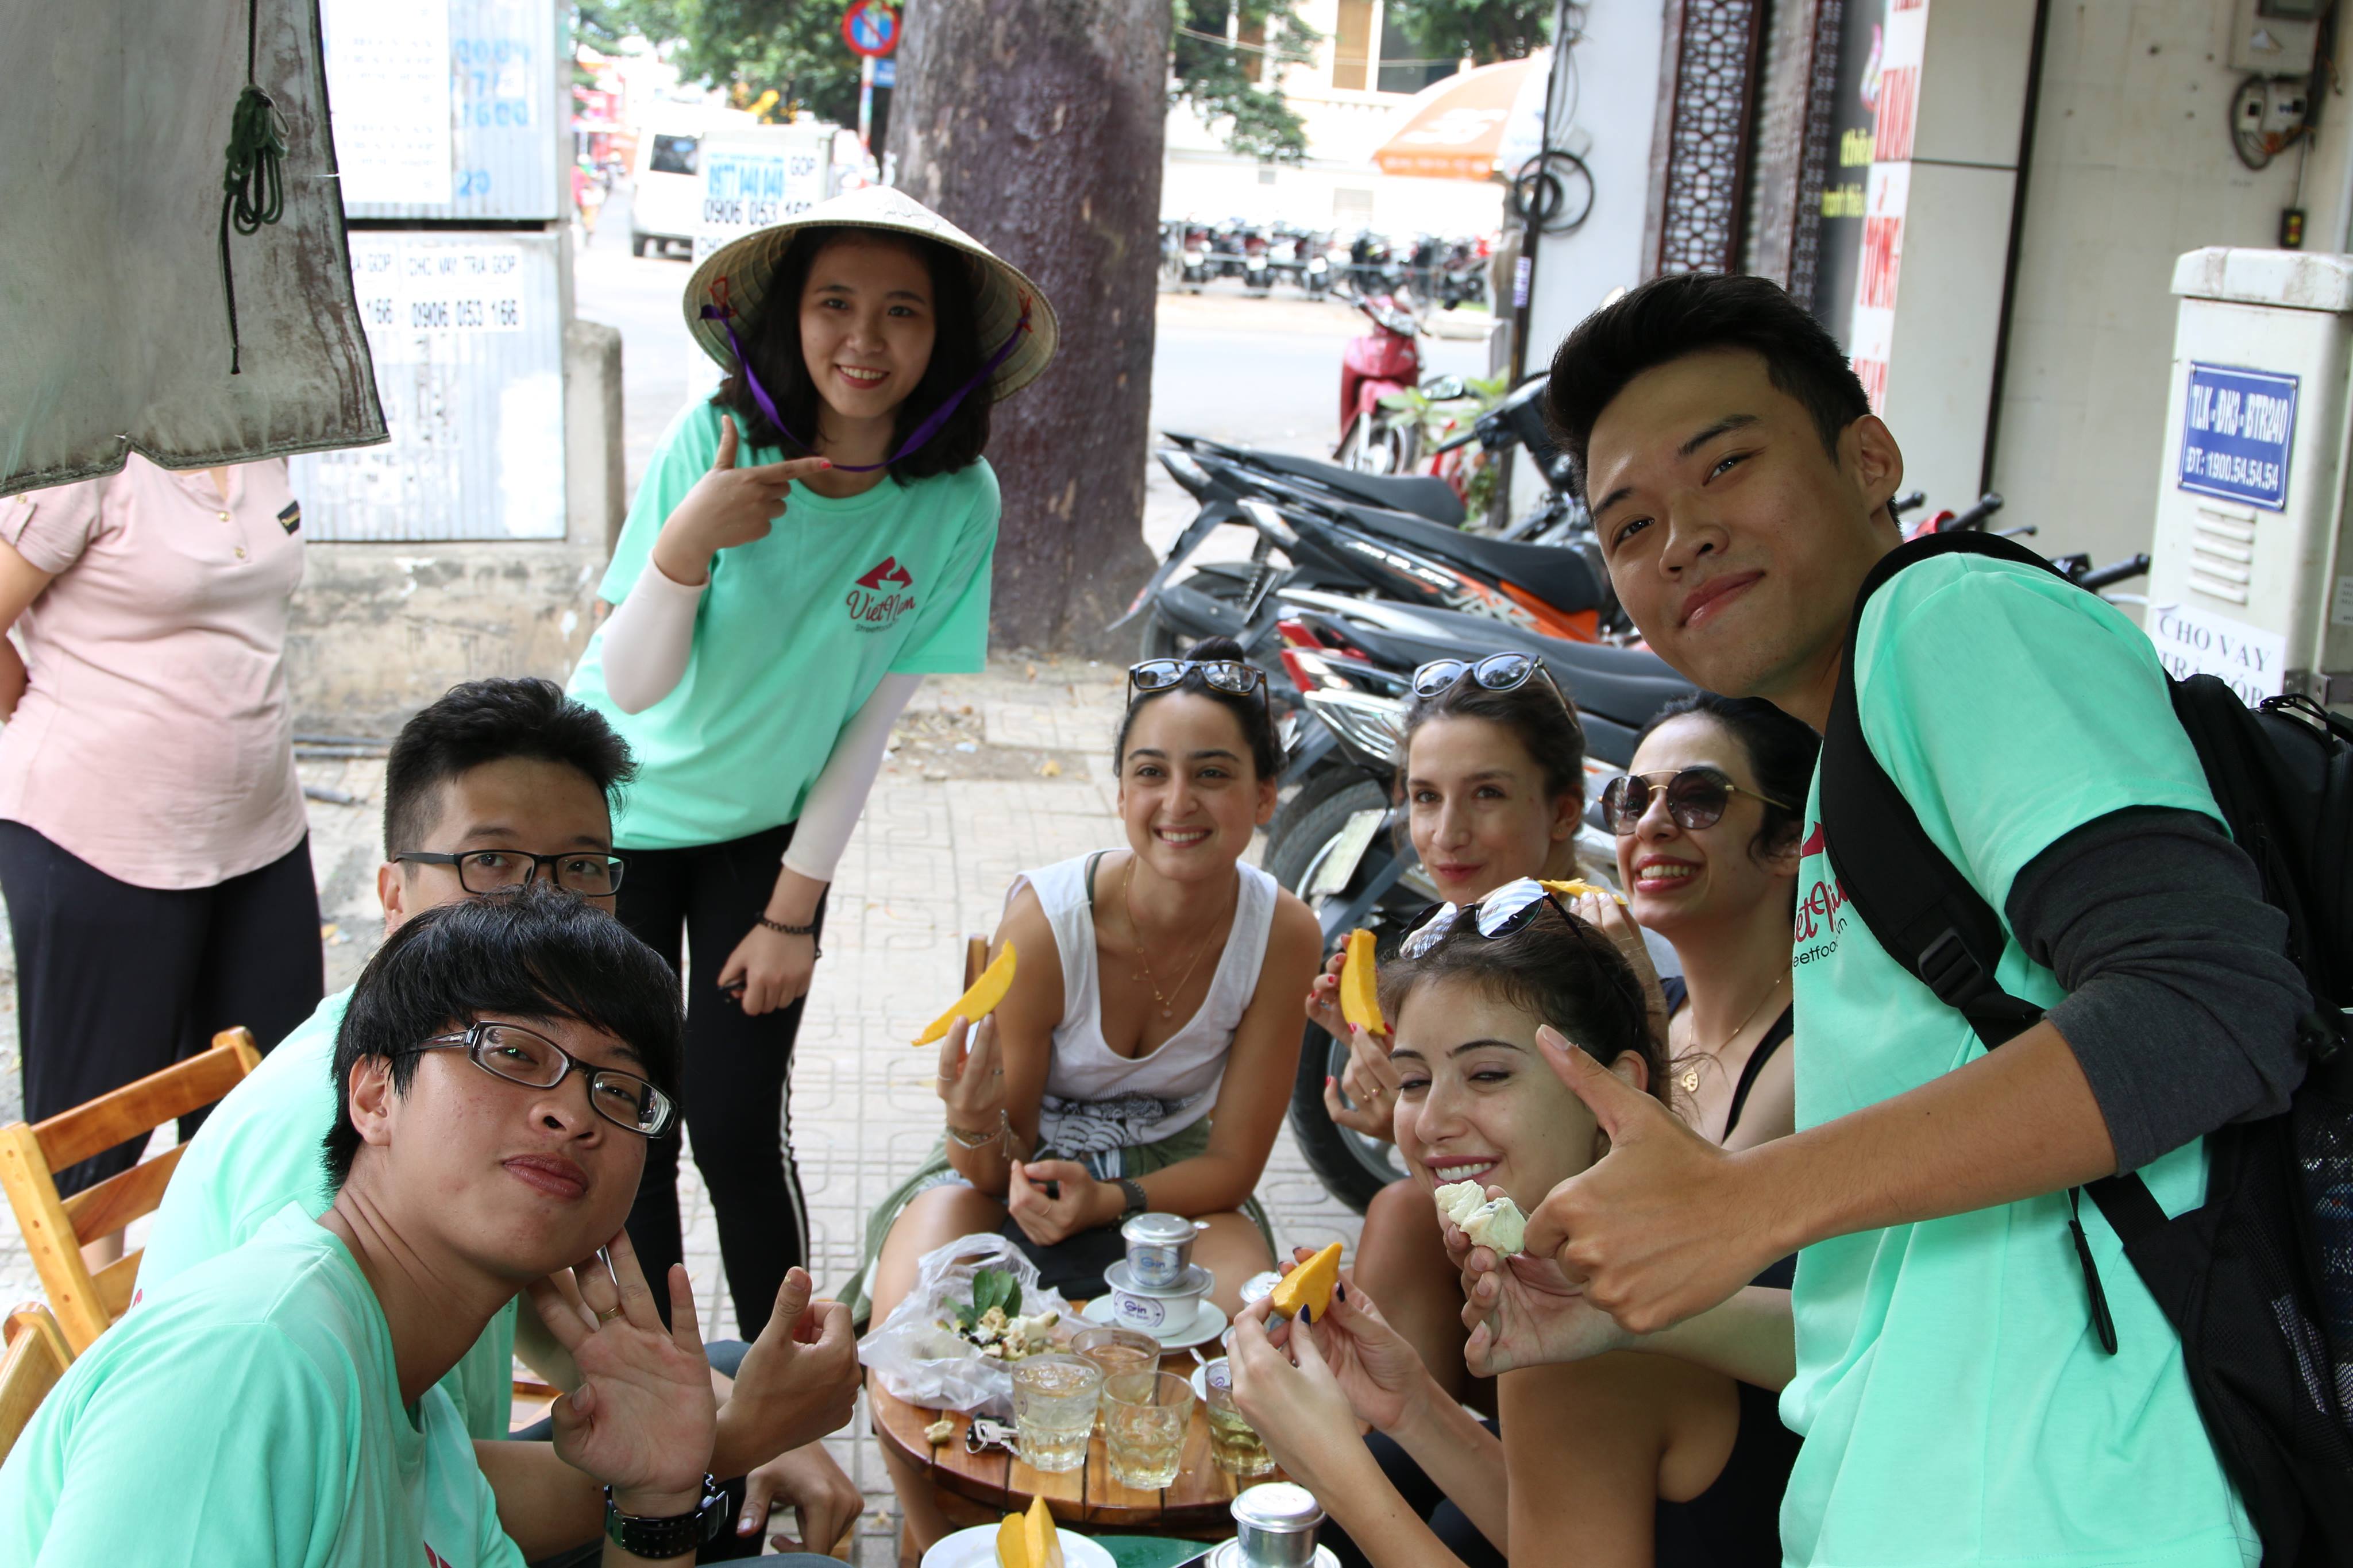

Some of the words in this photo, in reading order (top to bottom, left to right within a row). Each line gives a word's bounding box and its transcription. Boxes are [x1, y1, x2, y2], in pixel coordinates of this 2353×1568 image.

[412, 301, 449, 328] 0906
[491, 298, 518, 326] 166
[2207, 450, 2279, 492] 1900.54.54.54
[2160, 614, 2211, 651] CHO
[2220, 633, 2271, 672] VAY
[2215, 673, 2264, 708] ÓP
[1125, 1300, 1147, 1314] Gin
